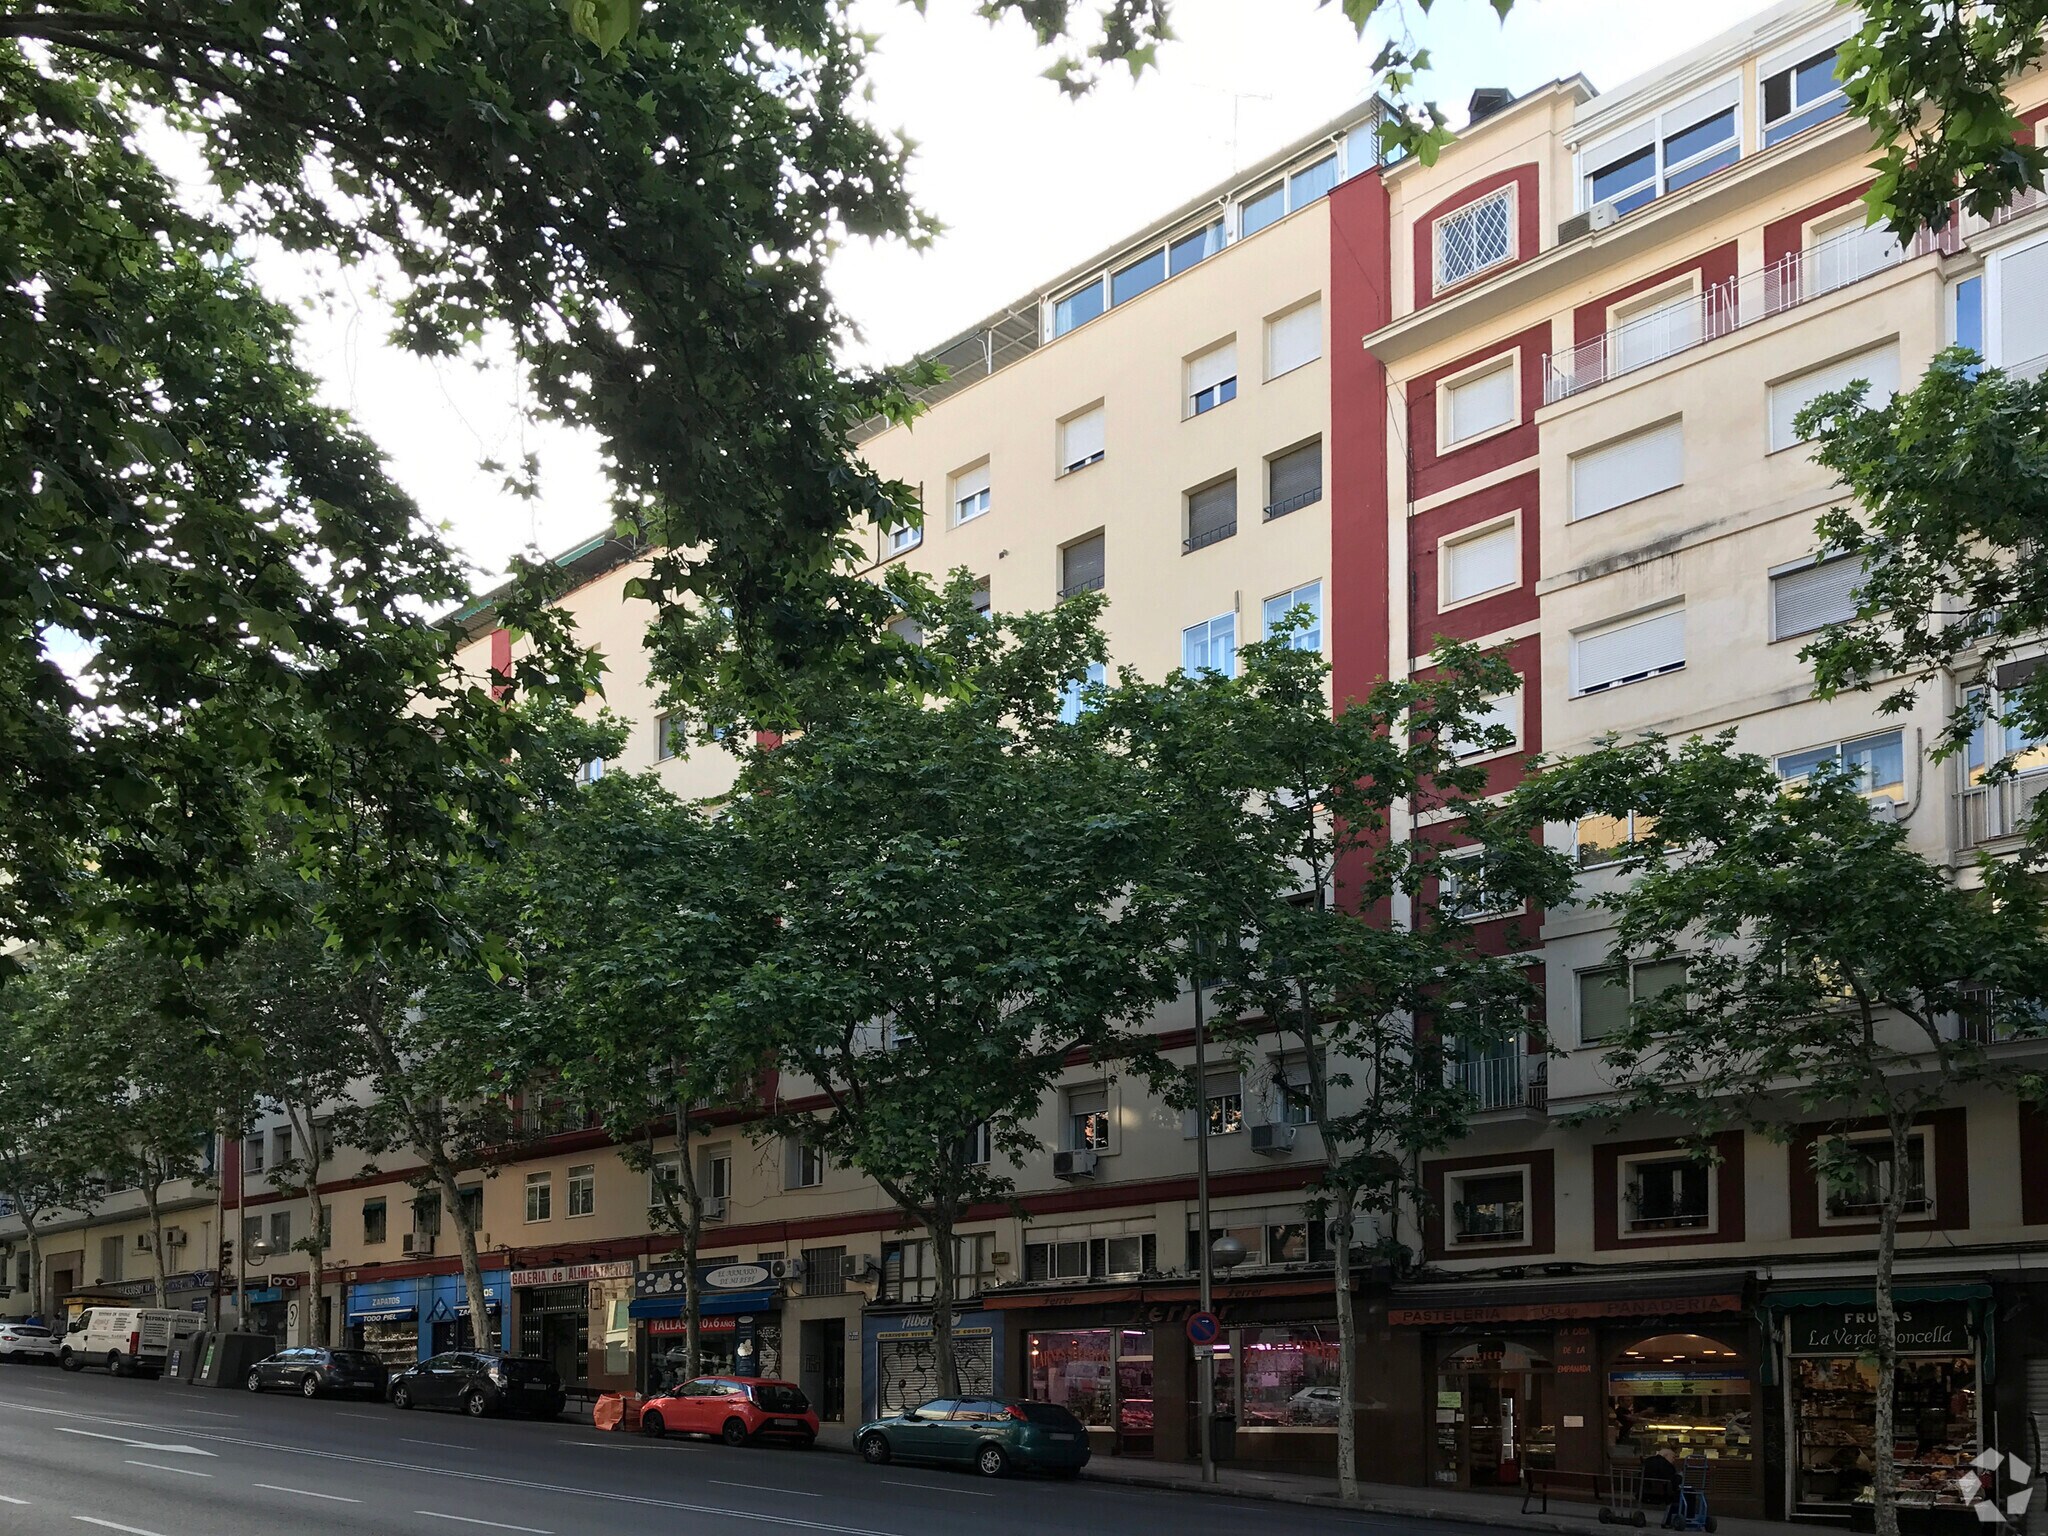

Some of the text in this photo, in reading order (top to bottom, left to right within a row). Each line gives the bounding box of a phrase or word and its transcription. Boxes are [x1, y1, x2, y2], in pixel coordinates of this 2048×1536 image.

[512, 1272, 547, 1285] GALERIA
[552, 1269, 562, 1282] de
[372, 1296, 401, 1307] ZAPATOS
[1403, 1308, 1500, 1321] PASTELERIA
[1844, 1311, 1913, 1324] FRUAS
[714, 1318, 720, 1328] 6
[1808, 1325, 1953, 1347] La Verde oncella
[1562, 1346, 1586, 1355] DE LA
